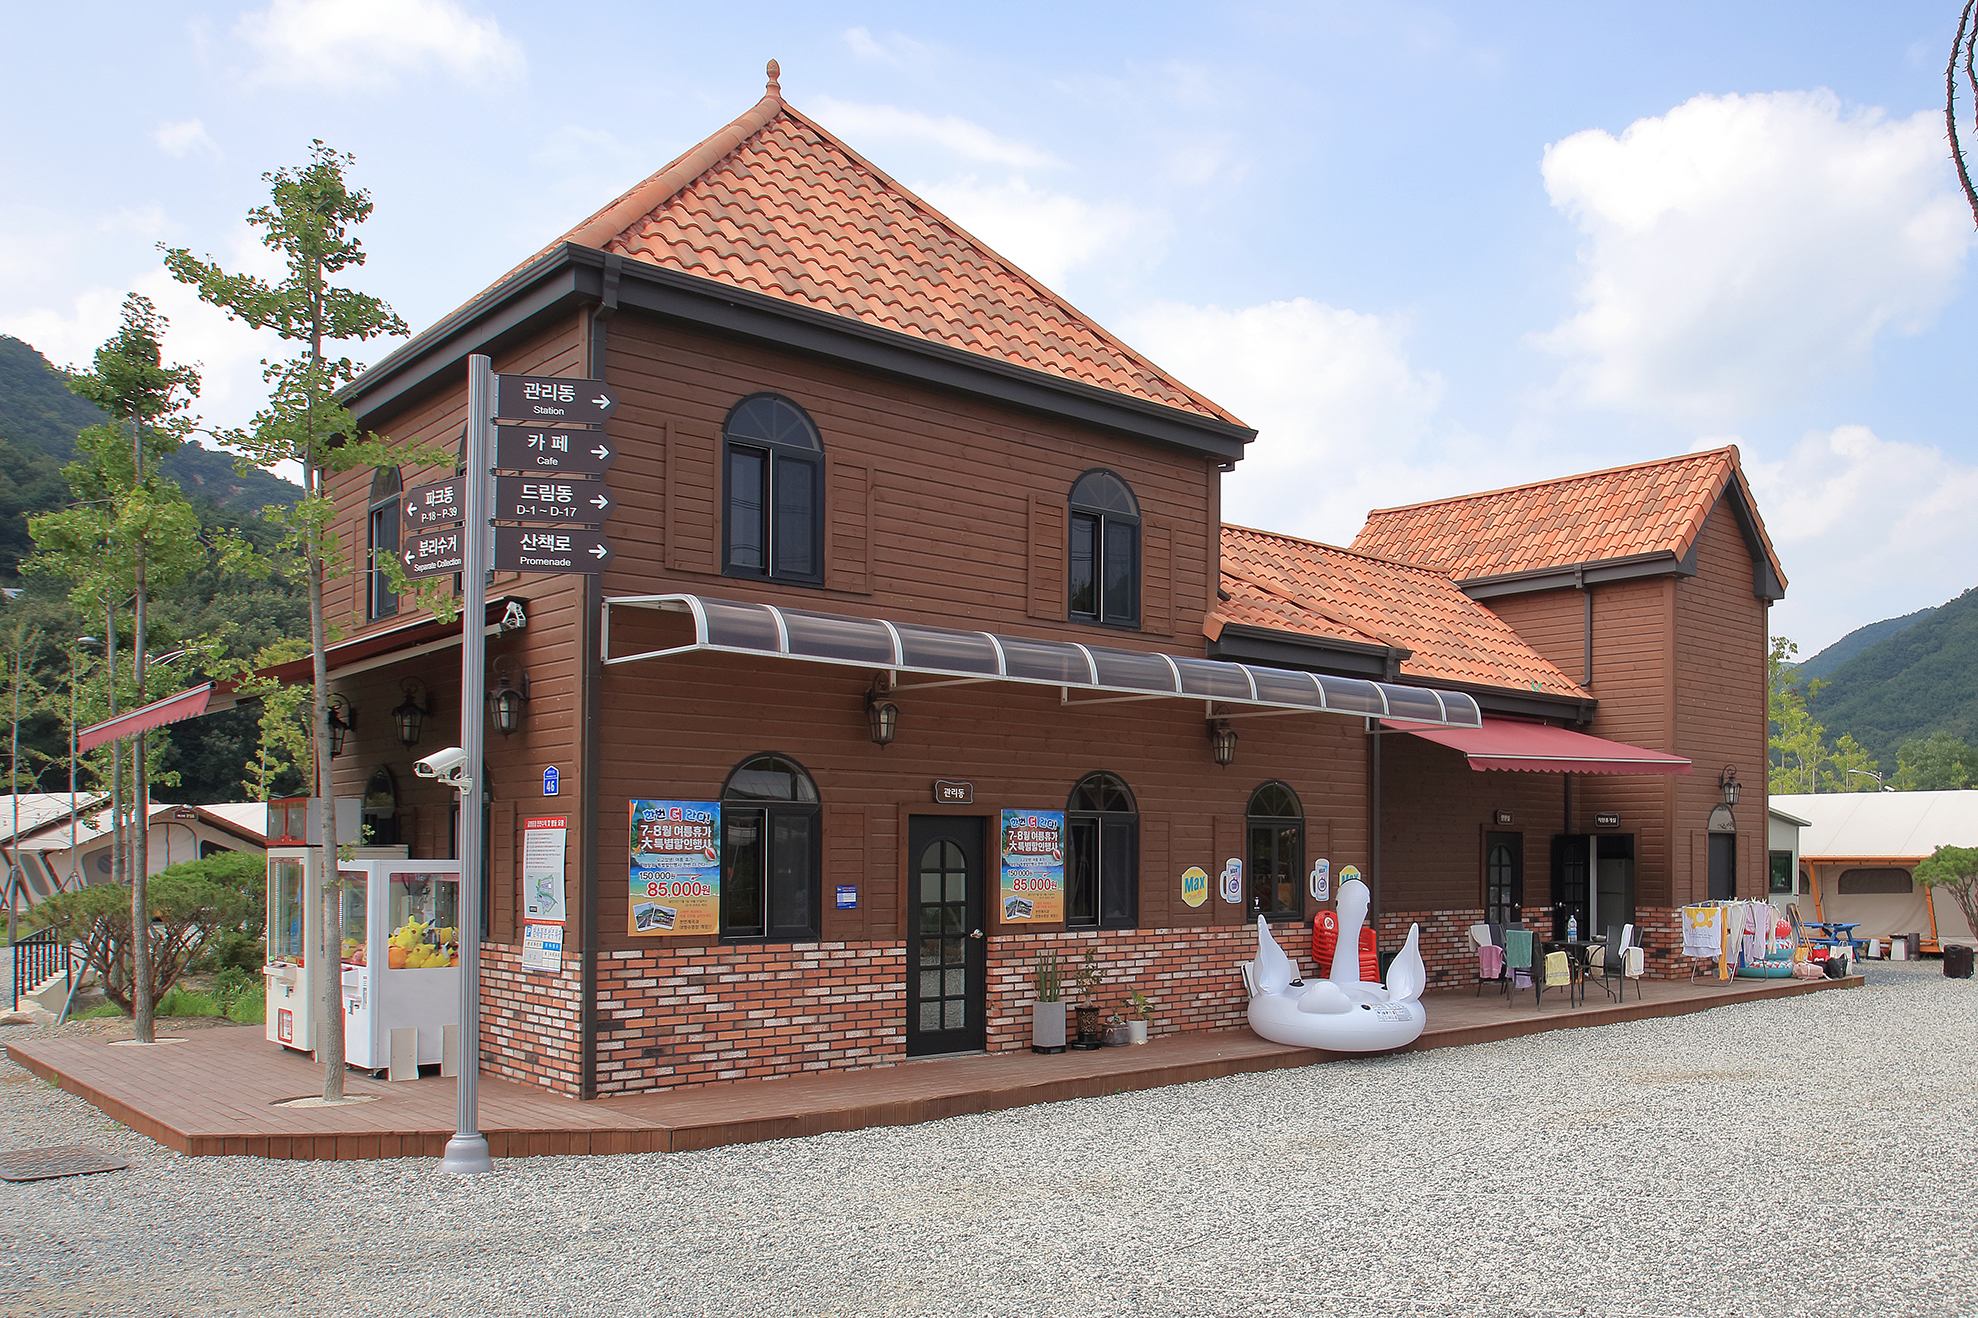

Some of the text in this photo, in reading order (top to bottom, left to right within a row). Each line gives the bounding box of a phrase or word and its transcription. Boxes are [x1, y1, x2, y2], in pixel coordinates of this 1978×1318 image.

[523, 382, 576, 403] 관리동
[533, 406, 564, 415] Station
[537, 456, 558, 466] Cafe
[425, 486, 454, 507] 파크동
[521, 484, 573, 503] 드림동
[517, 505, 536, 515] D-1
[551, 507, 577, 517] D-17
[419, 535, 457, 557] 분리수거
[520, 534, 572, 553] 산책로
[414, 557, 462, 572] Separate Collection
[520, 556, 571, 566] Promenade
[546, 781, 555, 791] 46
[944, 788, 965, 798] 관리동
[643, 808, 710, 824] 한번 더 간다!
[1010, 817, 1057, 830] 한번 더 간다!
[641, 825, 711, 837] 7~8월 여름휴가
[1032, 831, 1058, 841] 여름휴가
[648, 882, 711, 897] 85,000원
[1013, 879, 1057, 891] 85,000원
[1185, 877, 1205, 893] Max
